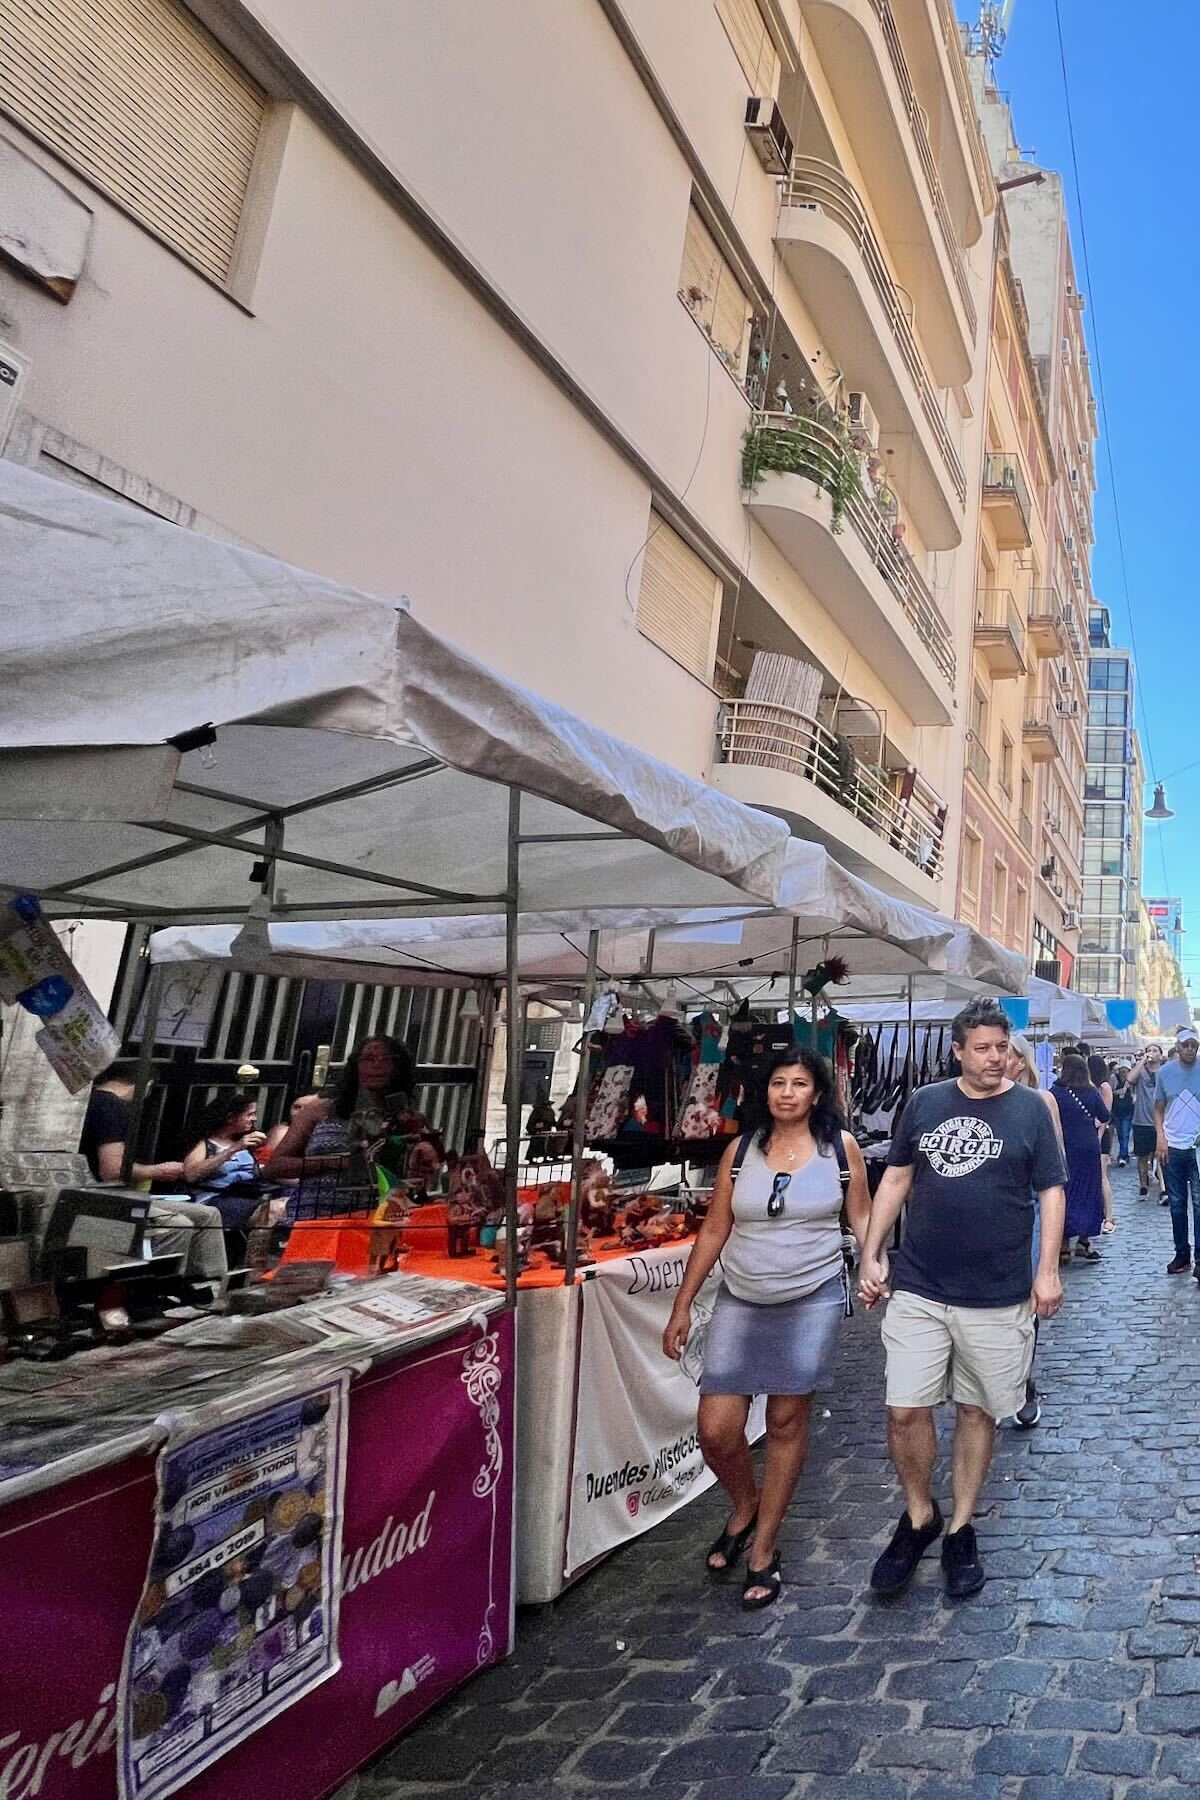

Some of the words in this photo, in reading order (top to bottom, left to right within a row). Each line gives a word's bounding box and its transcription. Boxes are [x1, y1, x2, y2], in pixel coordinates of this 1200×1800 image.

[938, 1119, 962, 1135] HIGH
[963, 1119, 990, 1139] GRADE
[626, 1256, 687, 1295] Duen
[262, 1455, 296, 1478] TODOS
[586, 1460, 650, 1503] Duendes
[340, 1490, 437, 1600] udad
